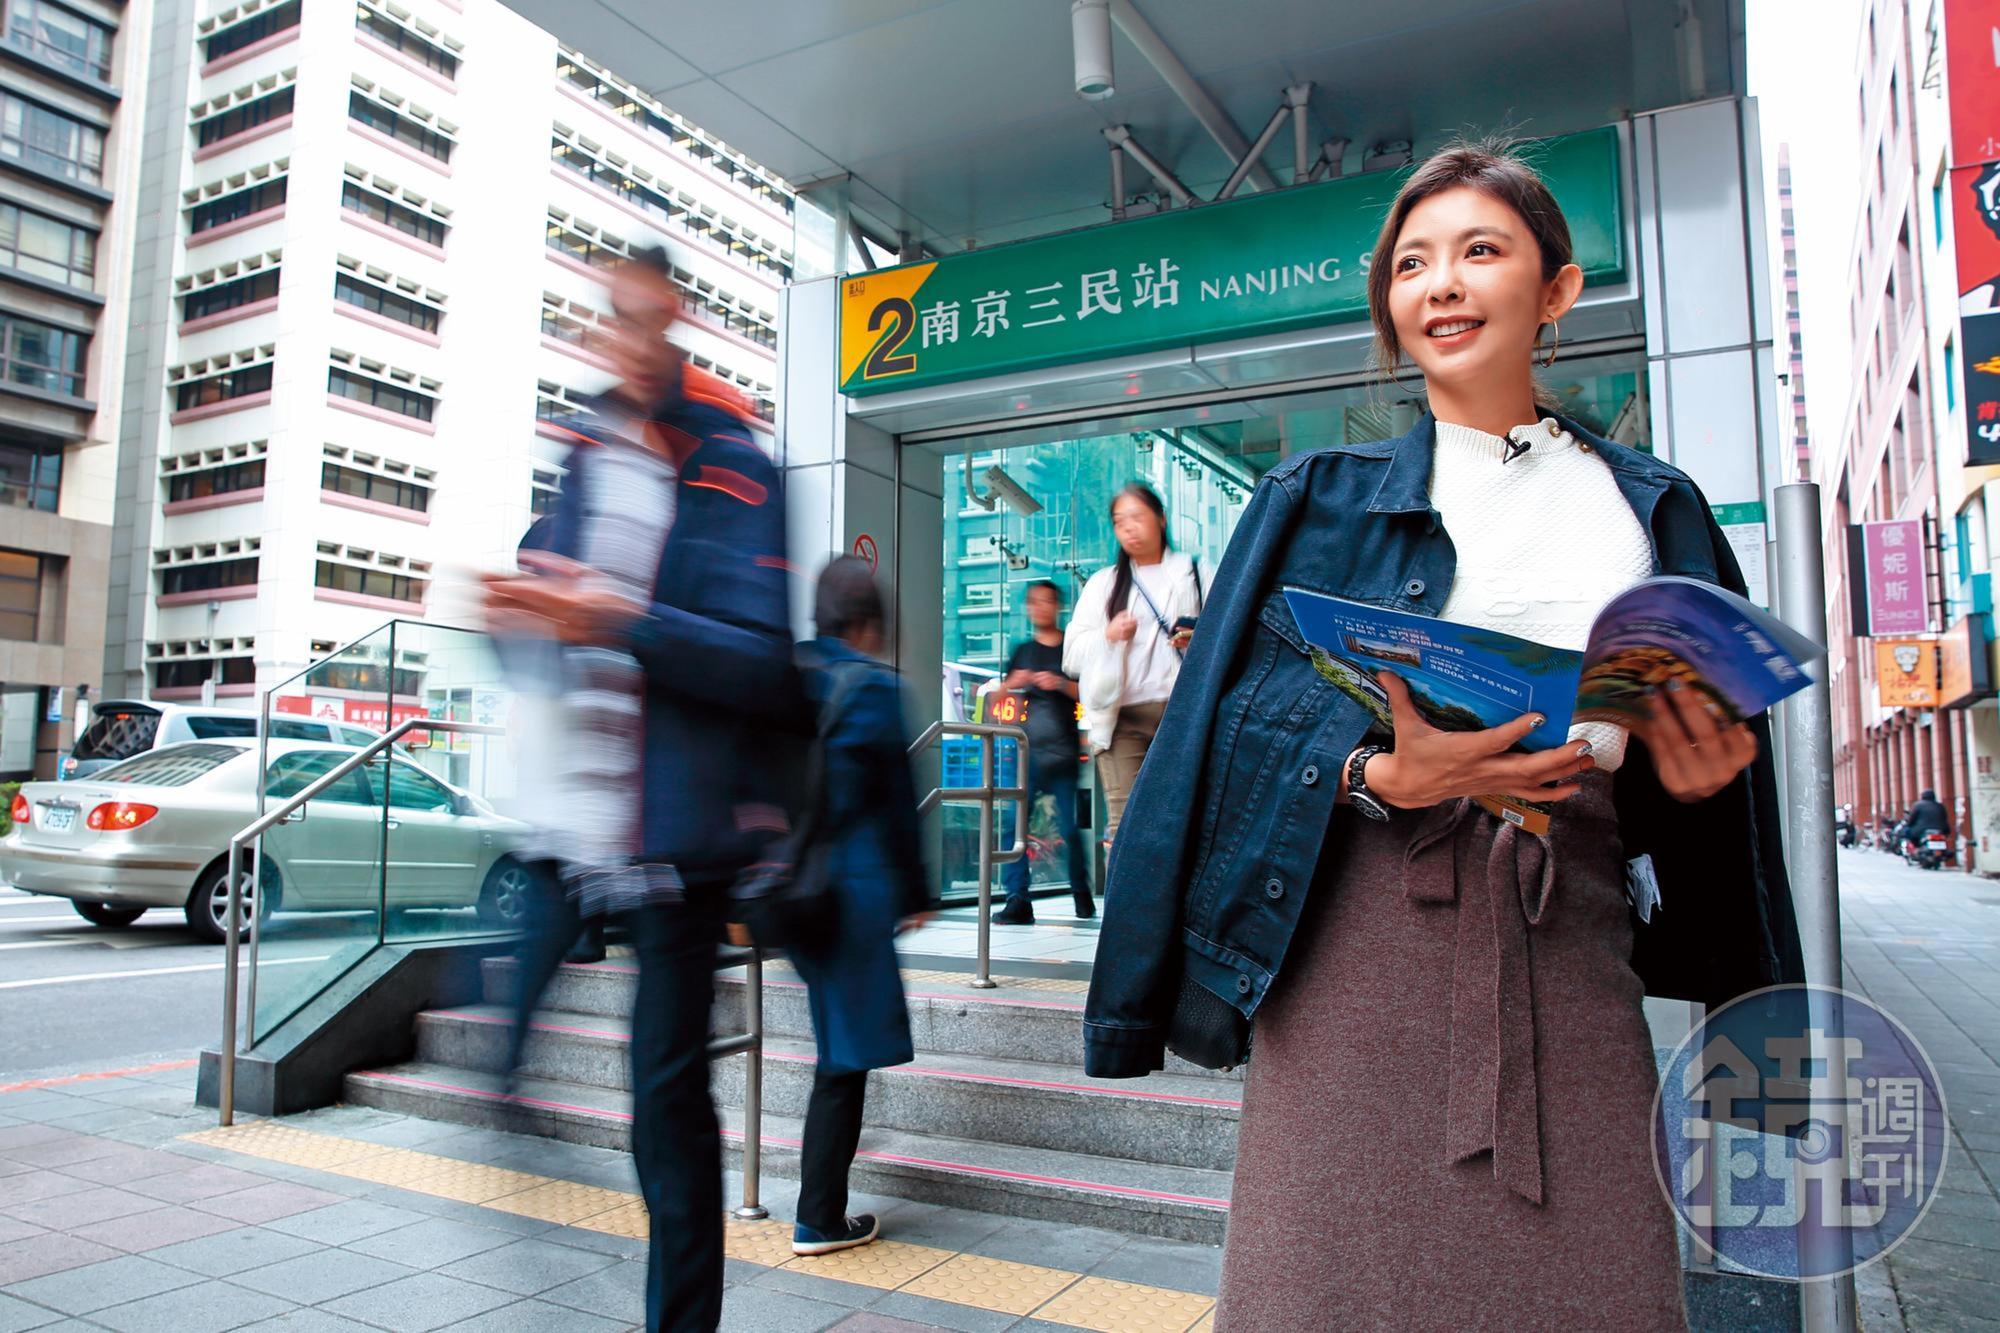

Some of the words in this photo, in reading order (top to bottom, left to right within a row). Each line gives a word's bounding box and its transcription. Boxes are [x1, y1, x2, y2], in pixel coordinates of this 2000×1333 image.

[919, 257, 1181, 349] 南京三民站
[1200, 258, 1341, 302] NANJING
[864, 296, 917, 380] 2
